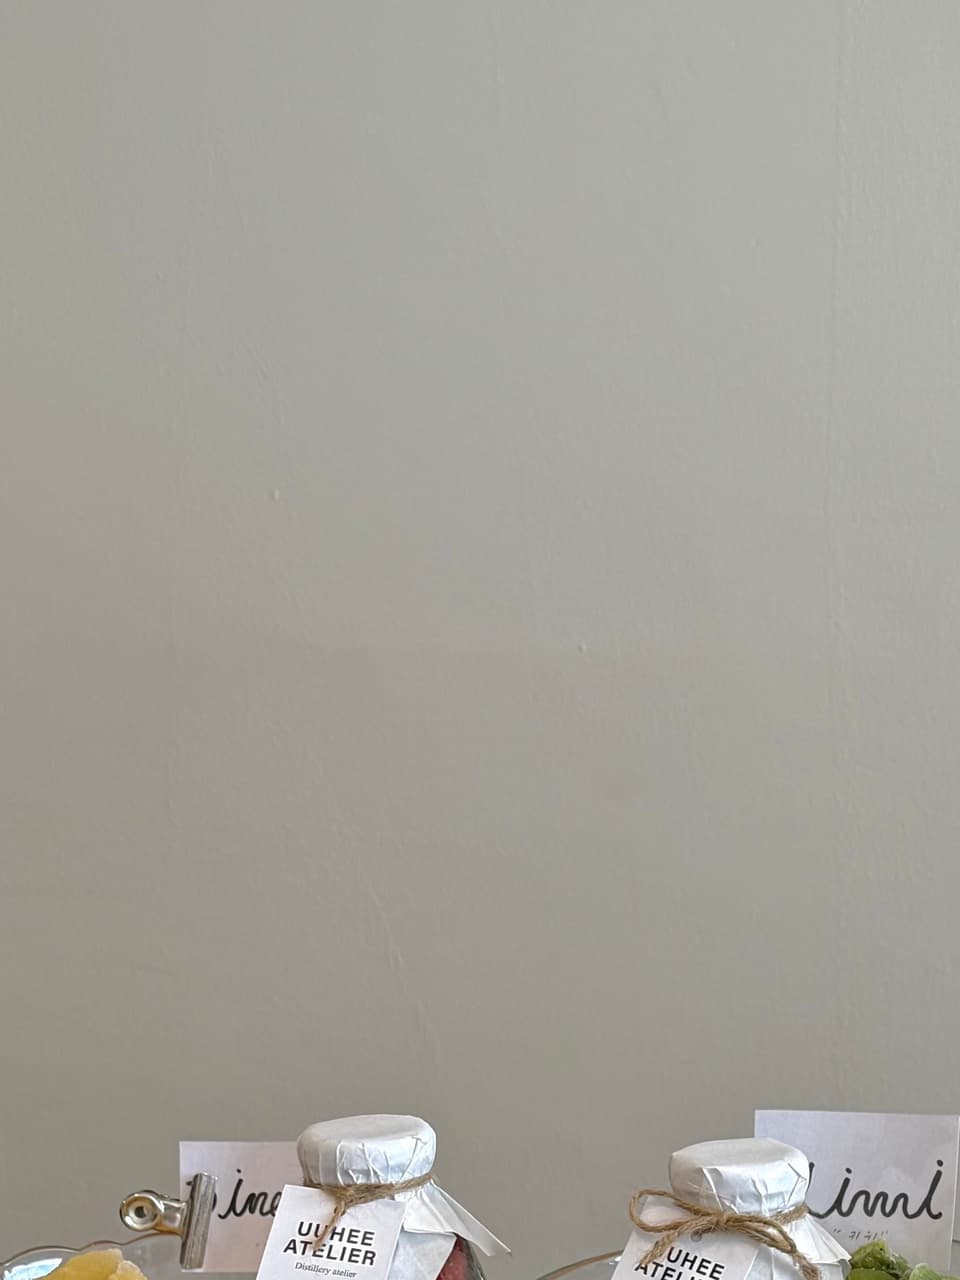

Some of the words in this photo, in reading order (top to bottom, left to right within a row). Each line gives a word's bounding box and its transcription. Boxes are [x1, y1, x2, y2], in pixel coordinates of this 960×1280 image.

[186, 1168, 282, 1219] ine
[283, 1239, 376, 1266] ATELIER
[667, 1247, 725, 1280] UHEE
[295, 1262, 331, 1276] Distillery
[332, 1269, 357, 1278] atelier
